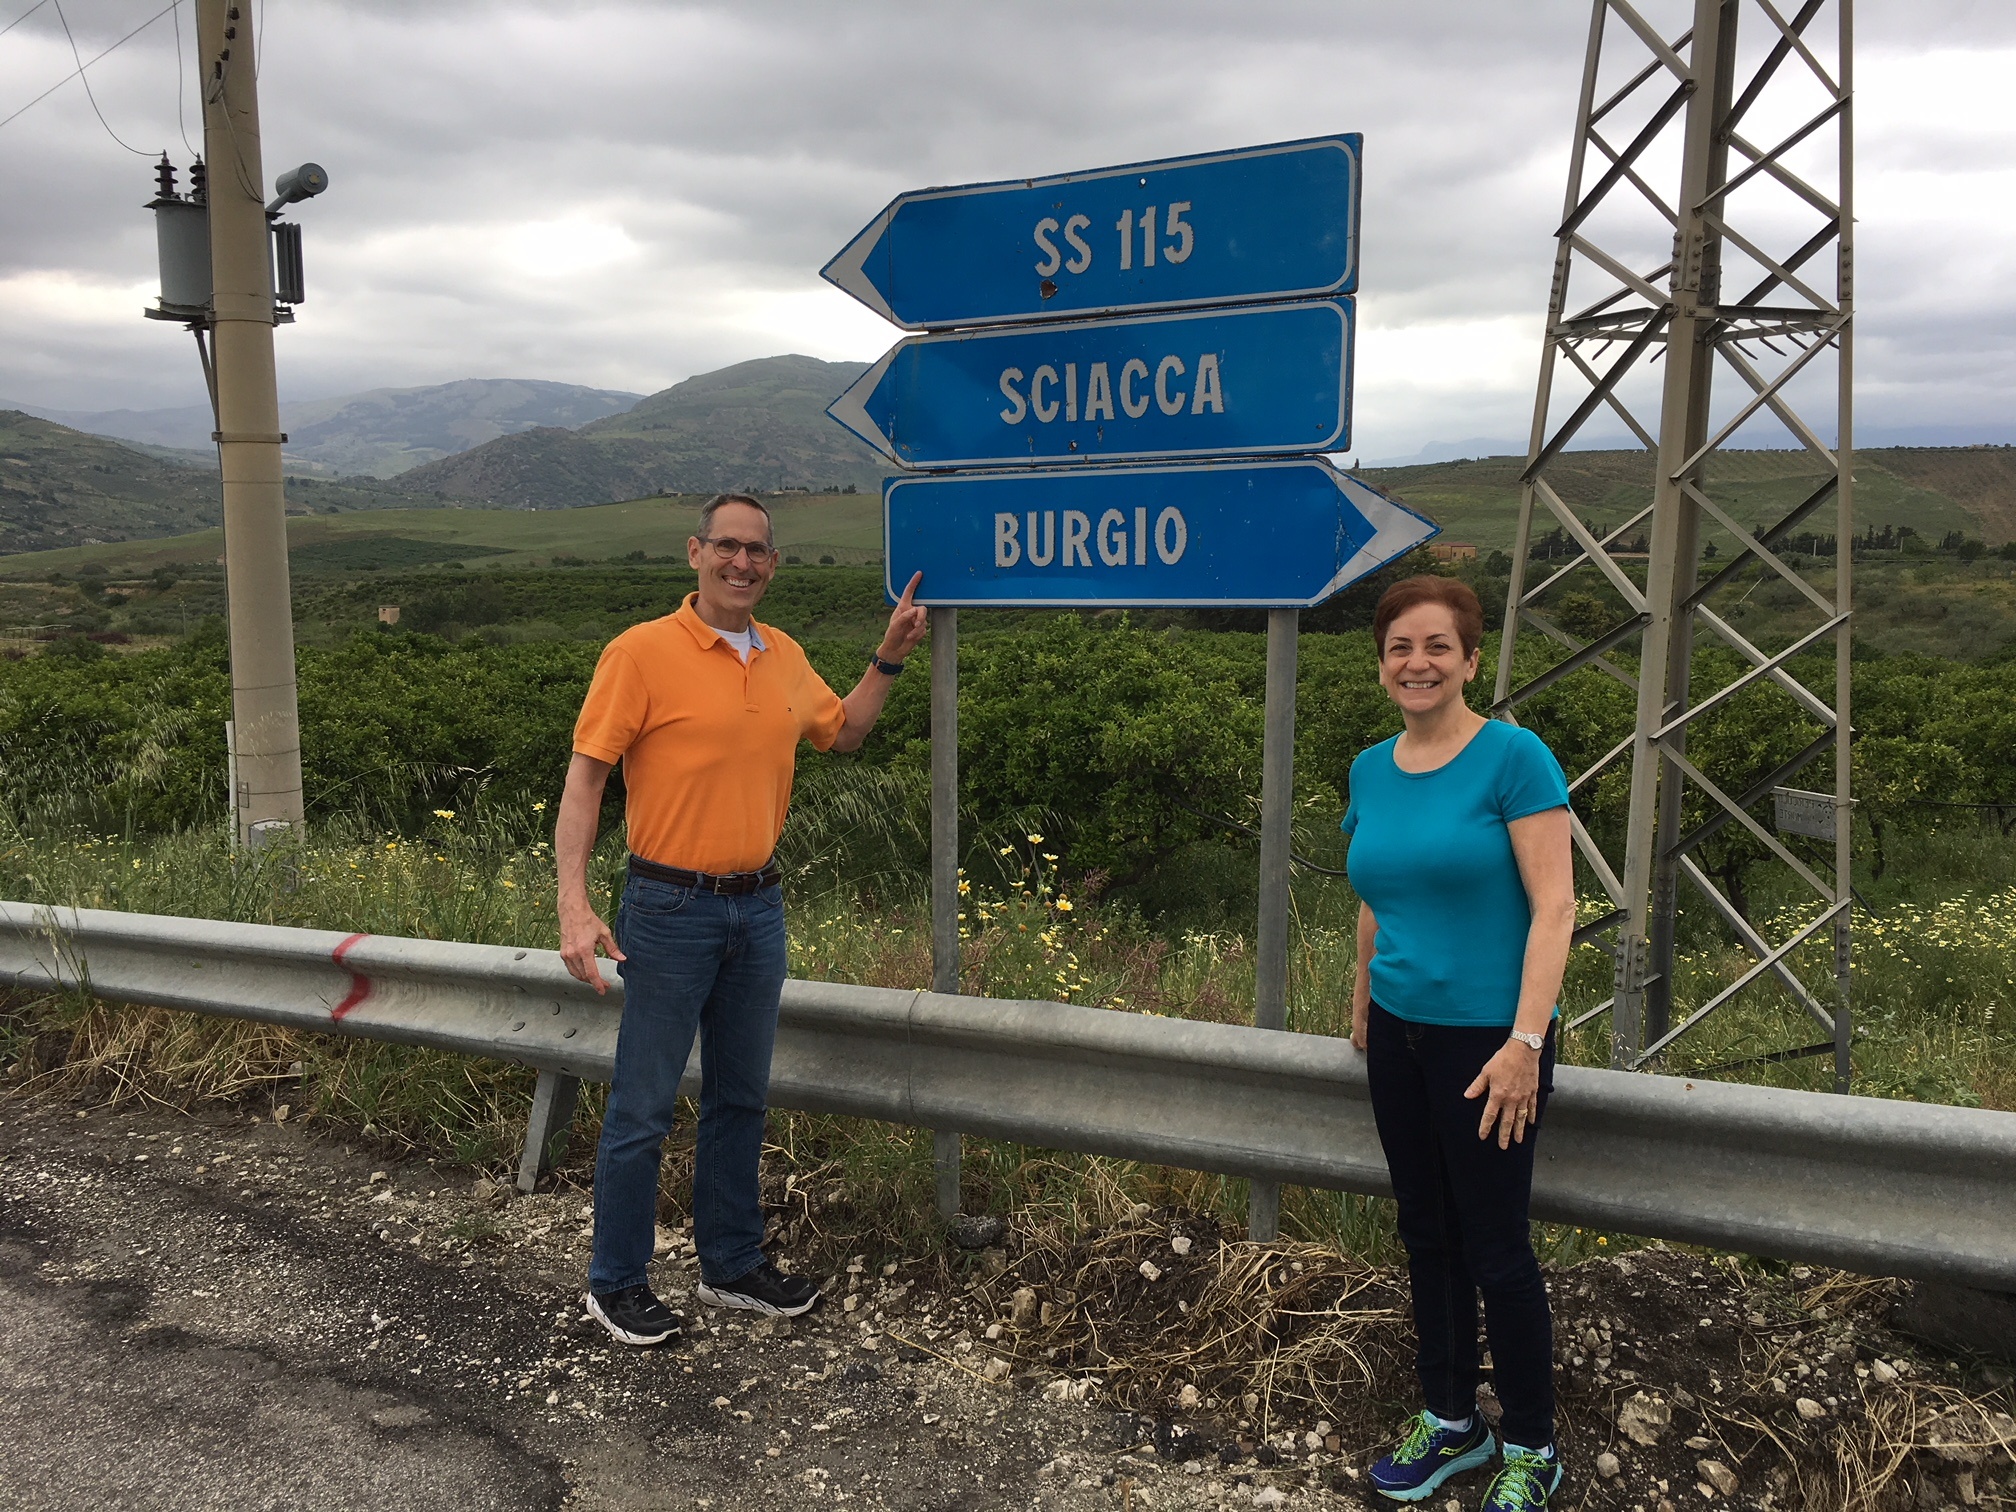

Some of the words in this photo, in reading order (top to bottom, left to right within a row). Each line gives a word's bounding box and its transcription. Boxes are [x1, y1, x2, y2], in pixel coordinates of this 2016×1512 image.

[1033, 214, 1092, 277] SS
[1116, 201, 1194, 270] 115
[999, 353, 1225, 425] SCIACCA
[994, 506, 1188, 568] BURGIO
